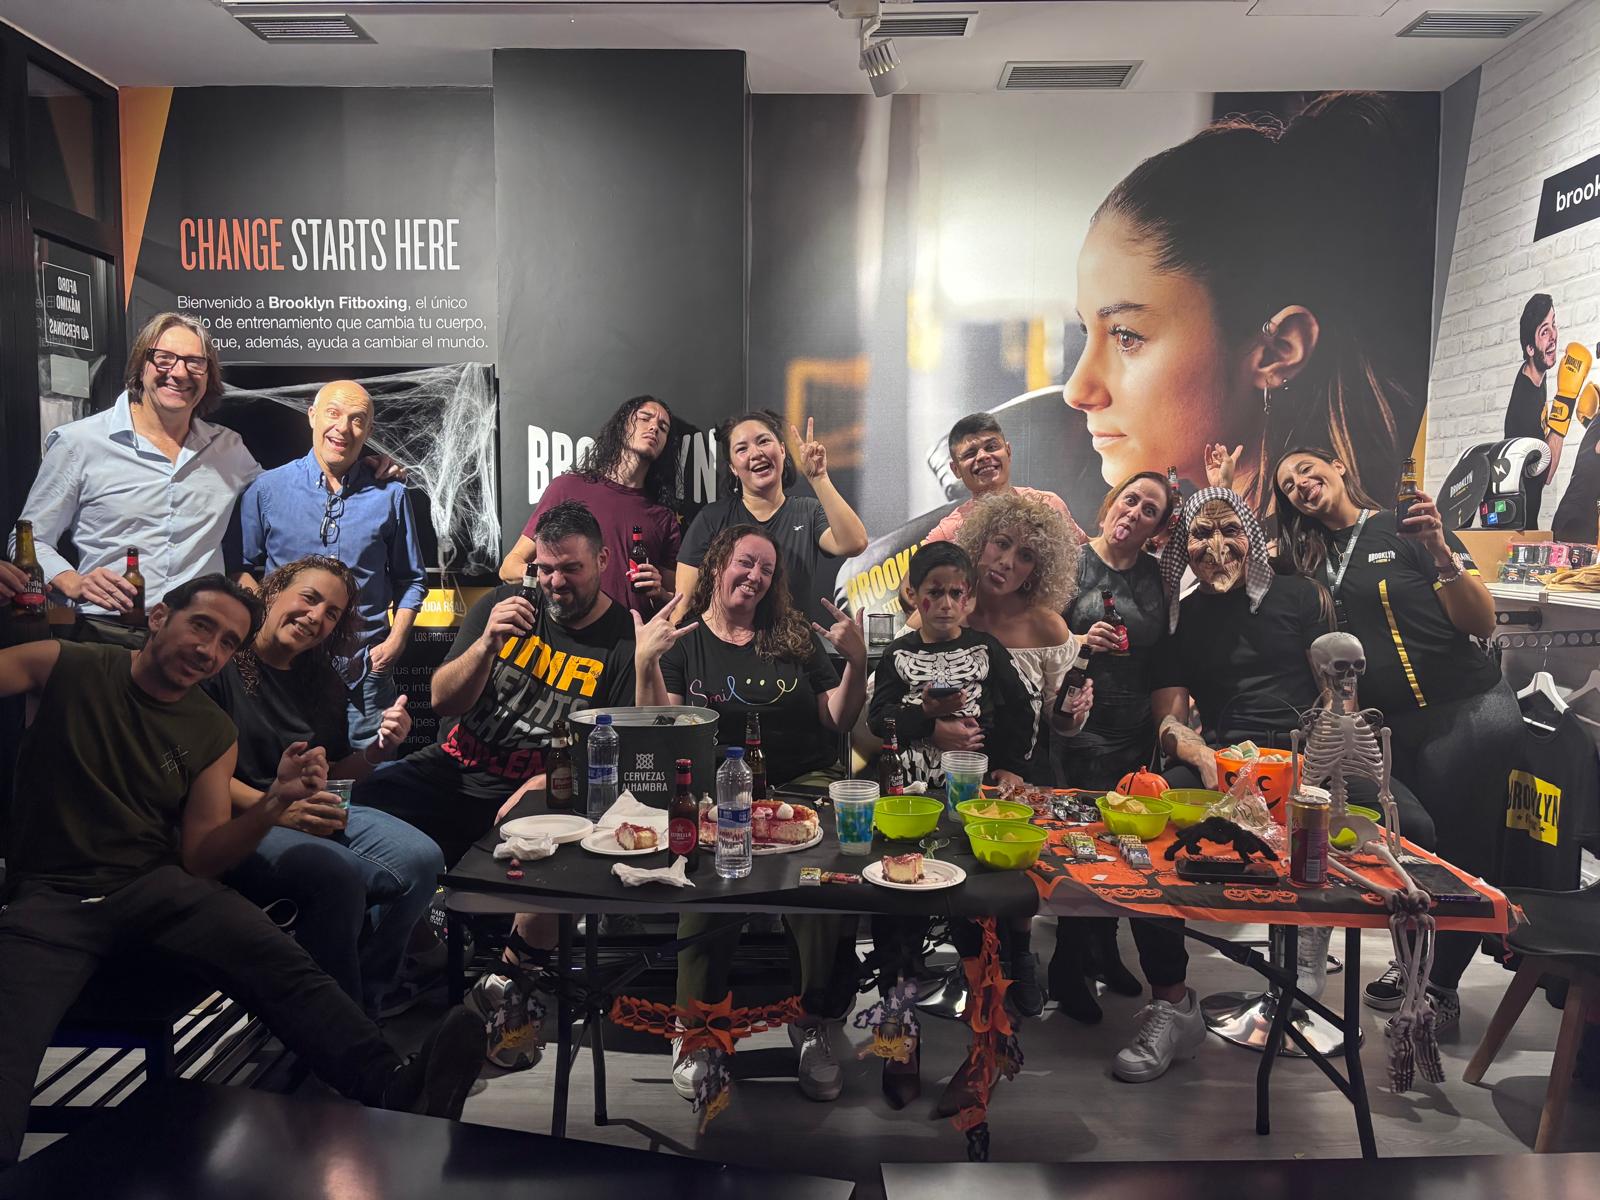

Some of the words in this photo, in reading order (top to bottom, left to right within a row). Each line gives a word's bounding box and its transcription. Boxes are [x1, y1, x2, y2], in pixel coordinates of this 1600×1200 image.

[180, 218, 285, 271] CHANGE
[291, 218, 387, 271] STARTS
[394, 218, 461, 271] HERE
[177, 296, 252, 309] Bienvenido
[256, 299, 265, 309] a
[269, 296, 335, 312] Brooklyn
[339, 296, 411, 312] Fitboxing,
[415, 296, 427, 309] el
[431, 295, 467, 309] único
[215, 316, 232, 329] de
[236, 317, 332, 329] entrenamiento
[336, 320, 362, 332] que
[366, 316, 415, 329] cambia
[418, 317, 432, 329] tu
[436, 320, 487, 332] cuerpo,
[211, 339, 241, 351] que,
[245, 335, 303, 350] además,
[307, 336, 348, 351] ayuda
[352, 339, 360, 349] a
[364, 336, 418, 349] cambiar
[422, 336, 433, 349] el
[437, 336, 489, 349] mundo.
[528, 424, 717, 504] BRYN
[1368, 550, 1396, 563] BROOKLYN
[415, 632, 427, 642] LOS
[428, 632, 457, 642] PROYECT
[623, 771, 666, 782] CERVEZAS
[622, 781, 668, 792] ALHAMBRA
